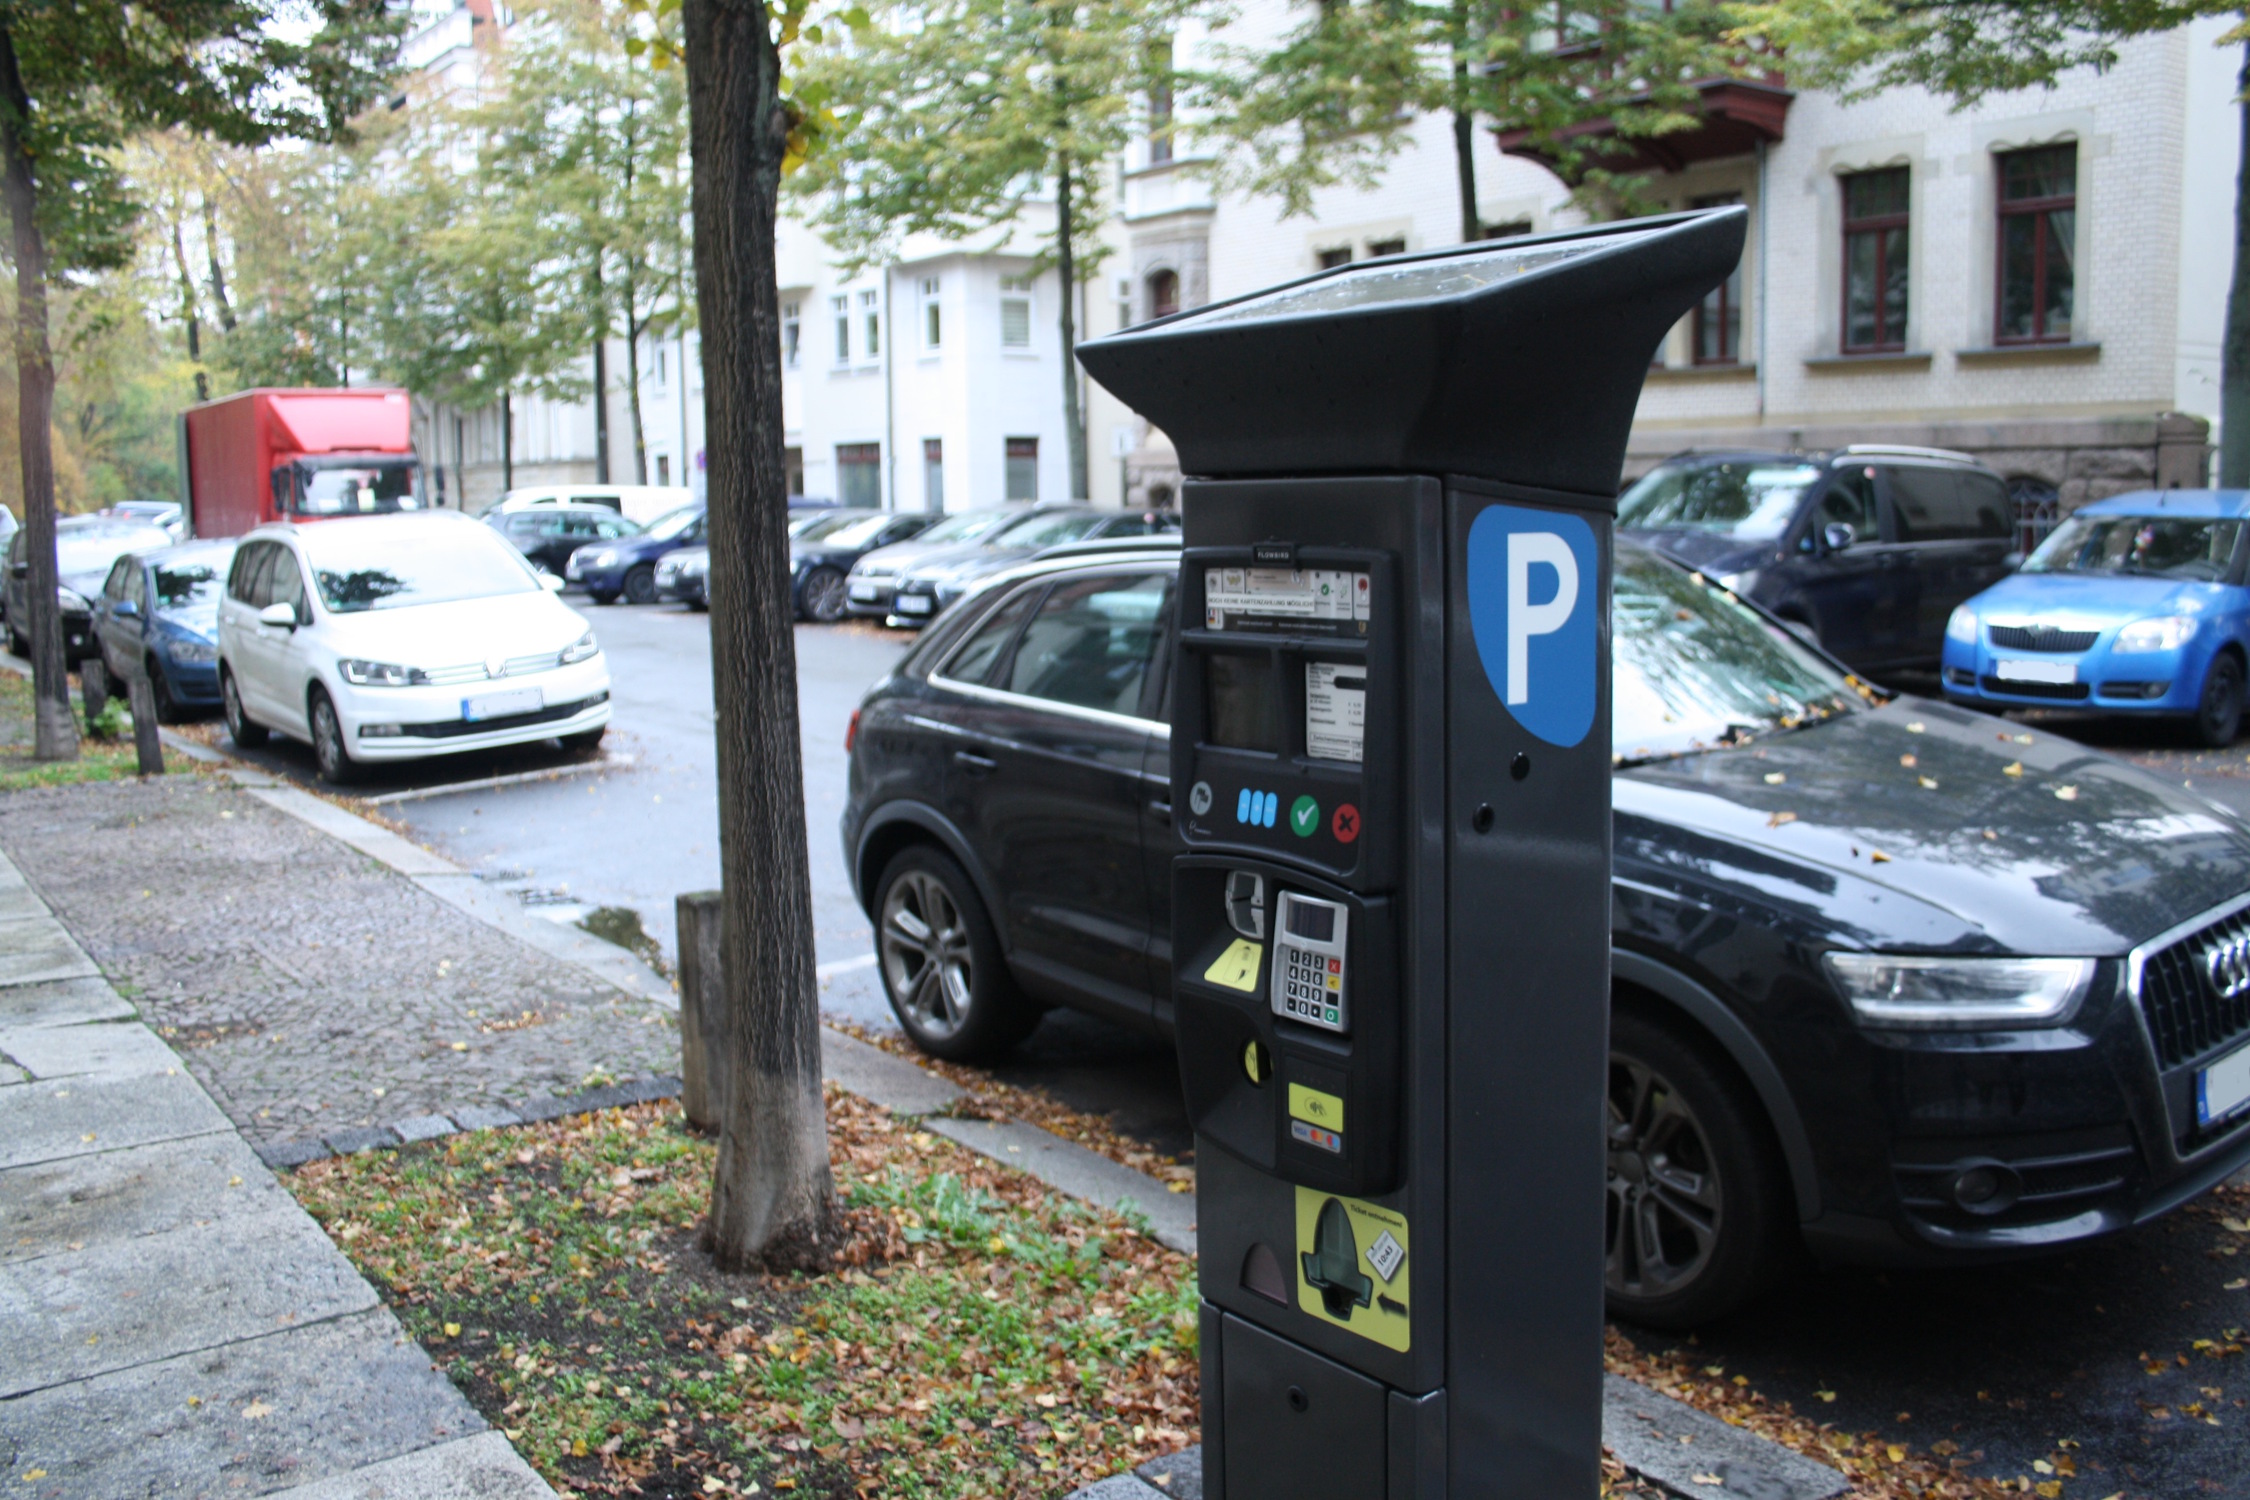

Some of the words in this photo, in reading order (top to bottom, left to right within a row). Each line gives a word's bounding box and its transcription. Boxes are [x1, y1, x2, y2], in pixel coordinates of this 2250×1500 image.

[1507, 532, 1579, 705] P
[1292, 951, 1297, 962] 1
[1304, 954, 1309, 965] 2
[1316, 957, 1321, 967] 3
[1290, 967, 1296, 978] 4
[1303, 970, 1308, 981] 5
[1315, 973, 1320, 984] 6
[1289, 983, 1295, 993] 7
[1301, 986, 1307, 997] 8
[1313, 989, 1319, 1000] 9
[1300, 1002, 1306, 1013] 0
[1350, 1204, 1367, 1216] Ticket
[1377, 1245, 1394, 1267] 10:43
